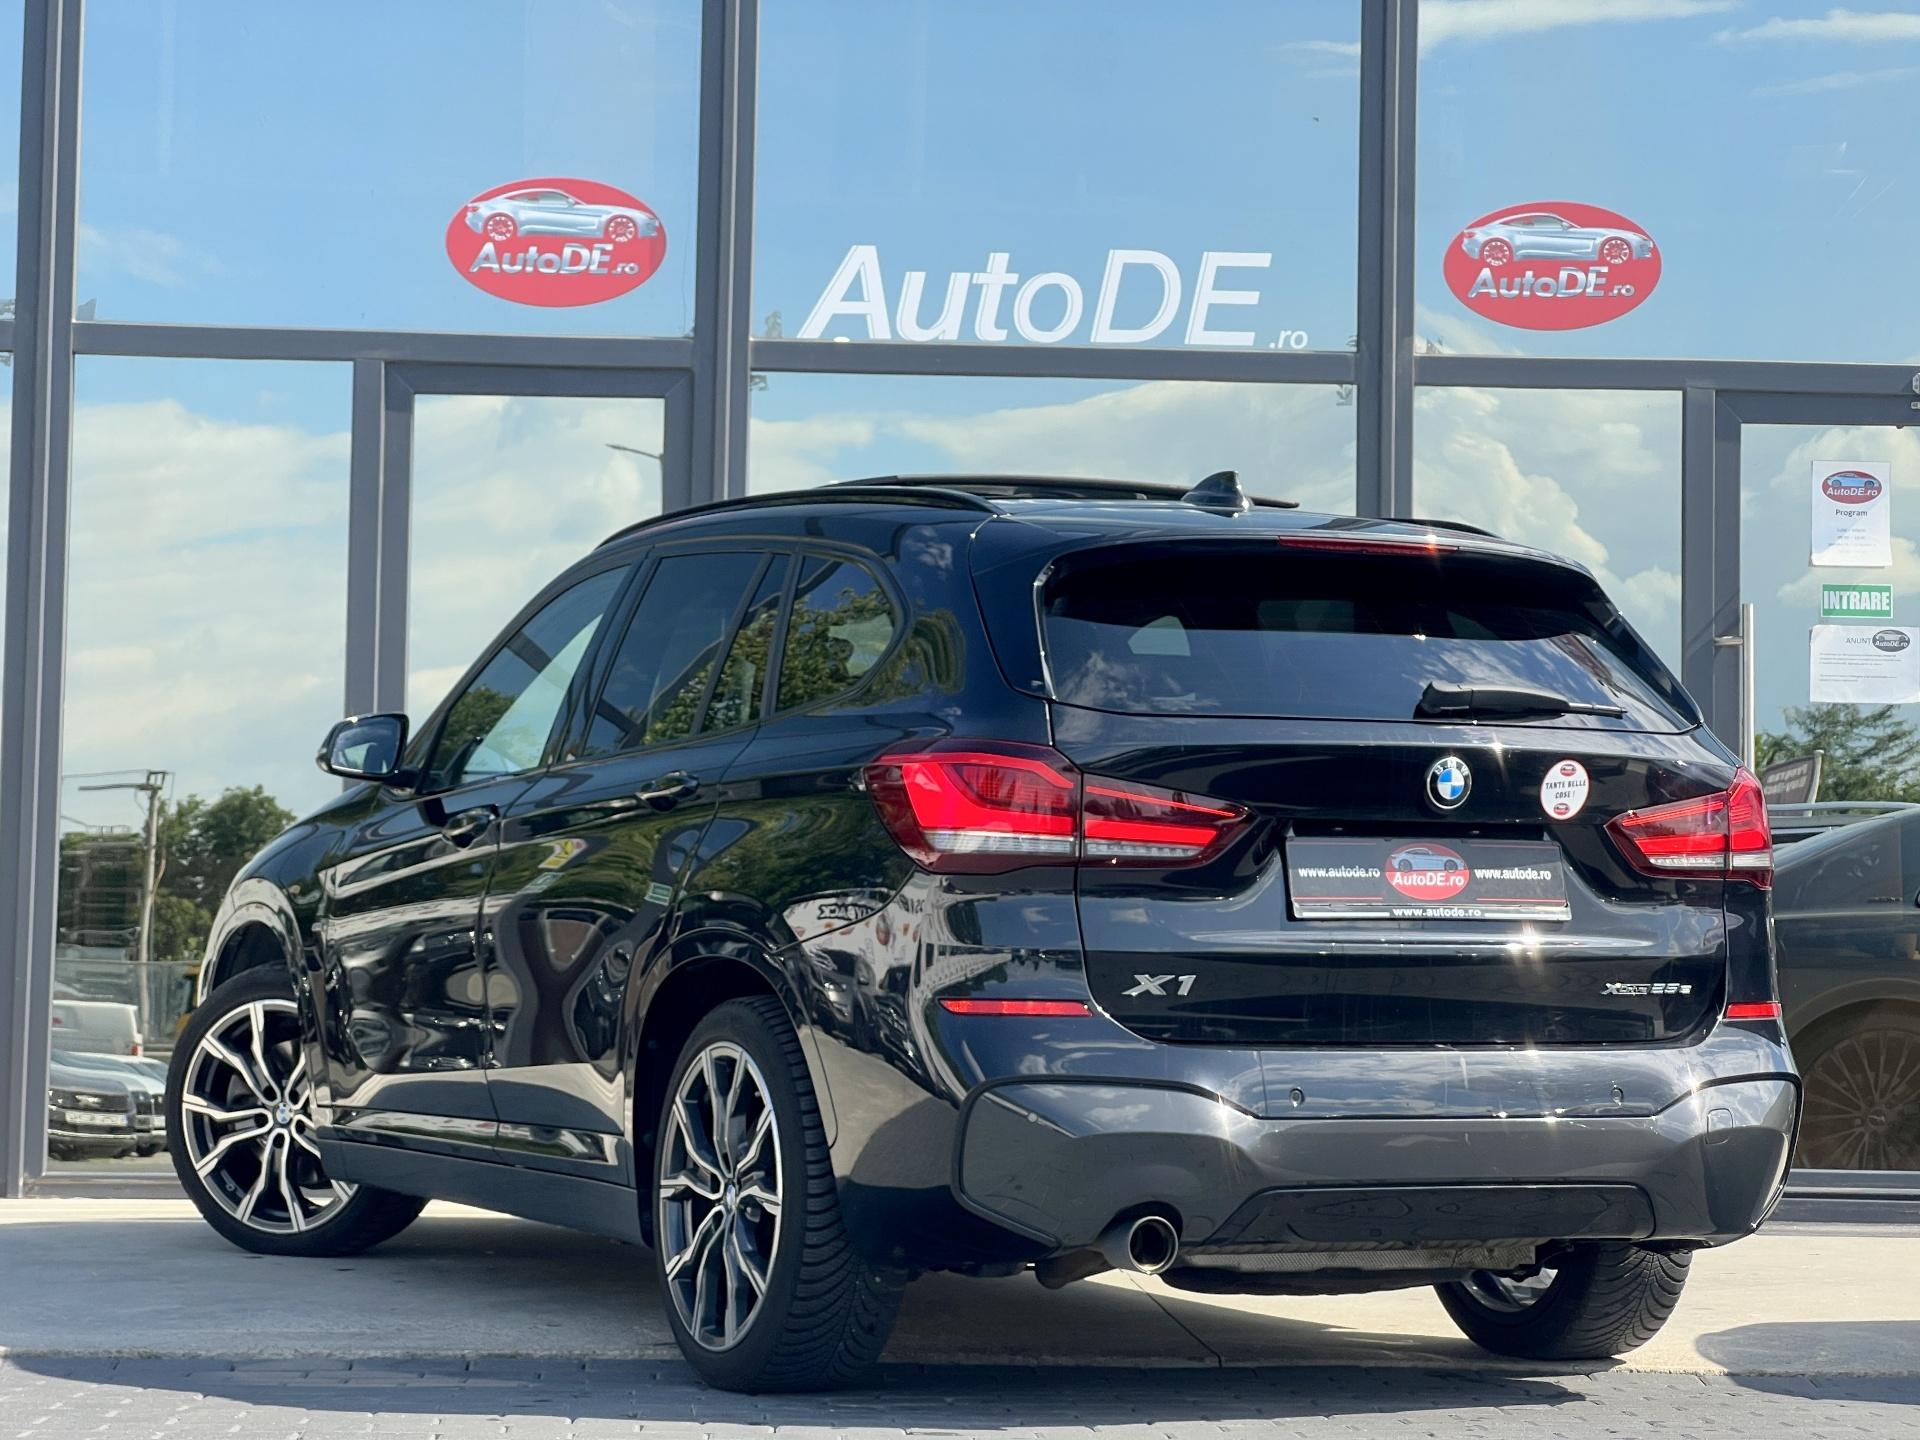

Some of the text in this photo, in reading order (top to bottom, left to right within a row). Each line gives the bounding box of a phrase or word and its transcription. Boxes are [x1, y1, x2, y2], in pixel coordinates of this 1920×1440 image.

[1835, 508, 1868, 518] Program
[1823, 590, 1890, 611] INTRARE
[1433, 758, 1470, 777] BMW
[1545, 779, 1586, 790] TANTE BELLE
[1298, 864, 1552, 887] www.autode.ro AutoDE.ro www.autode.ro
[1392, 906, 1482, 918] www.autode.ro
[1121, 974, 1197, 997] X1
